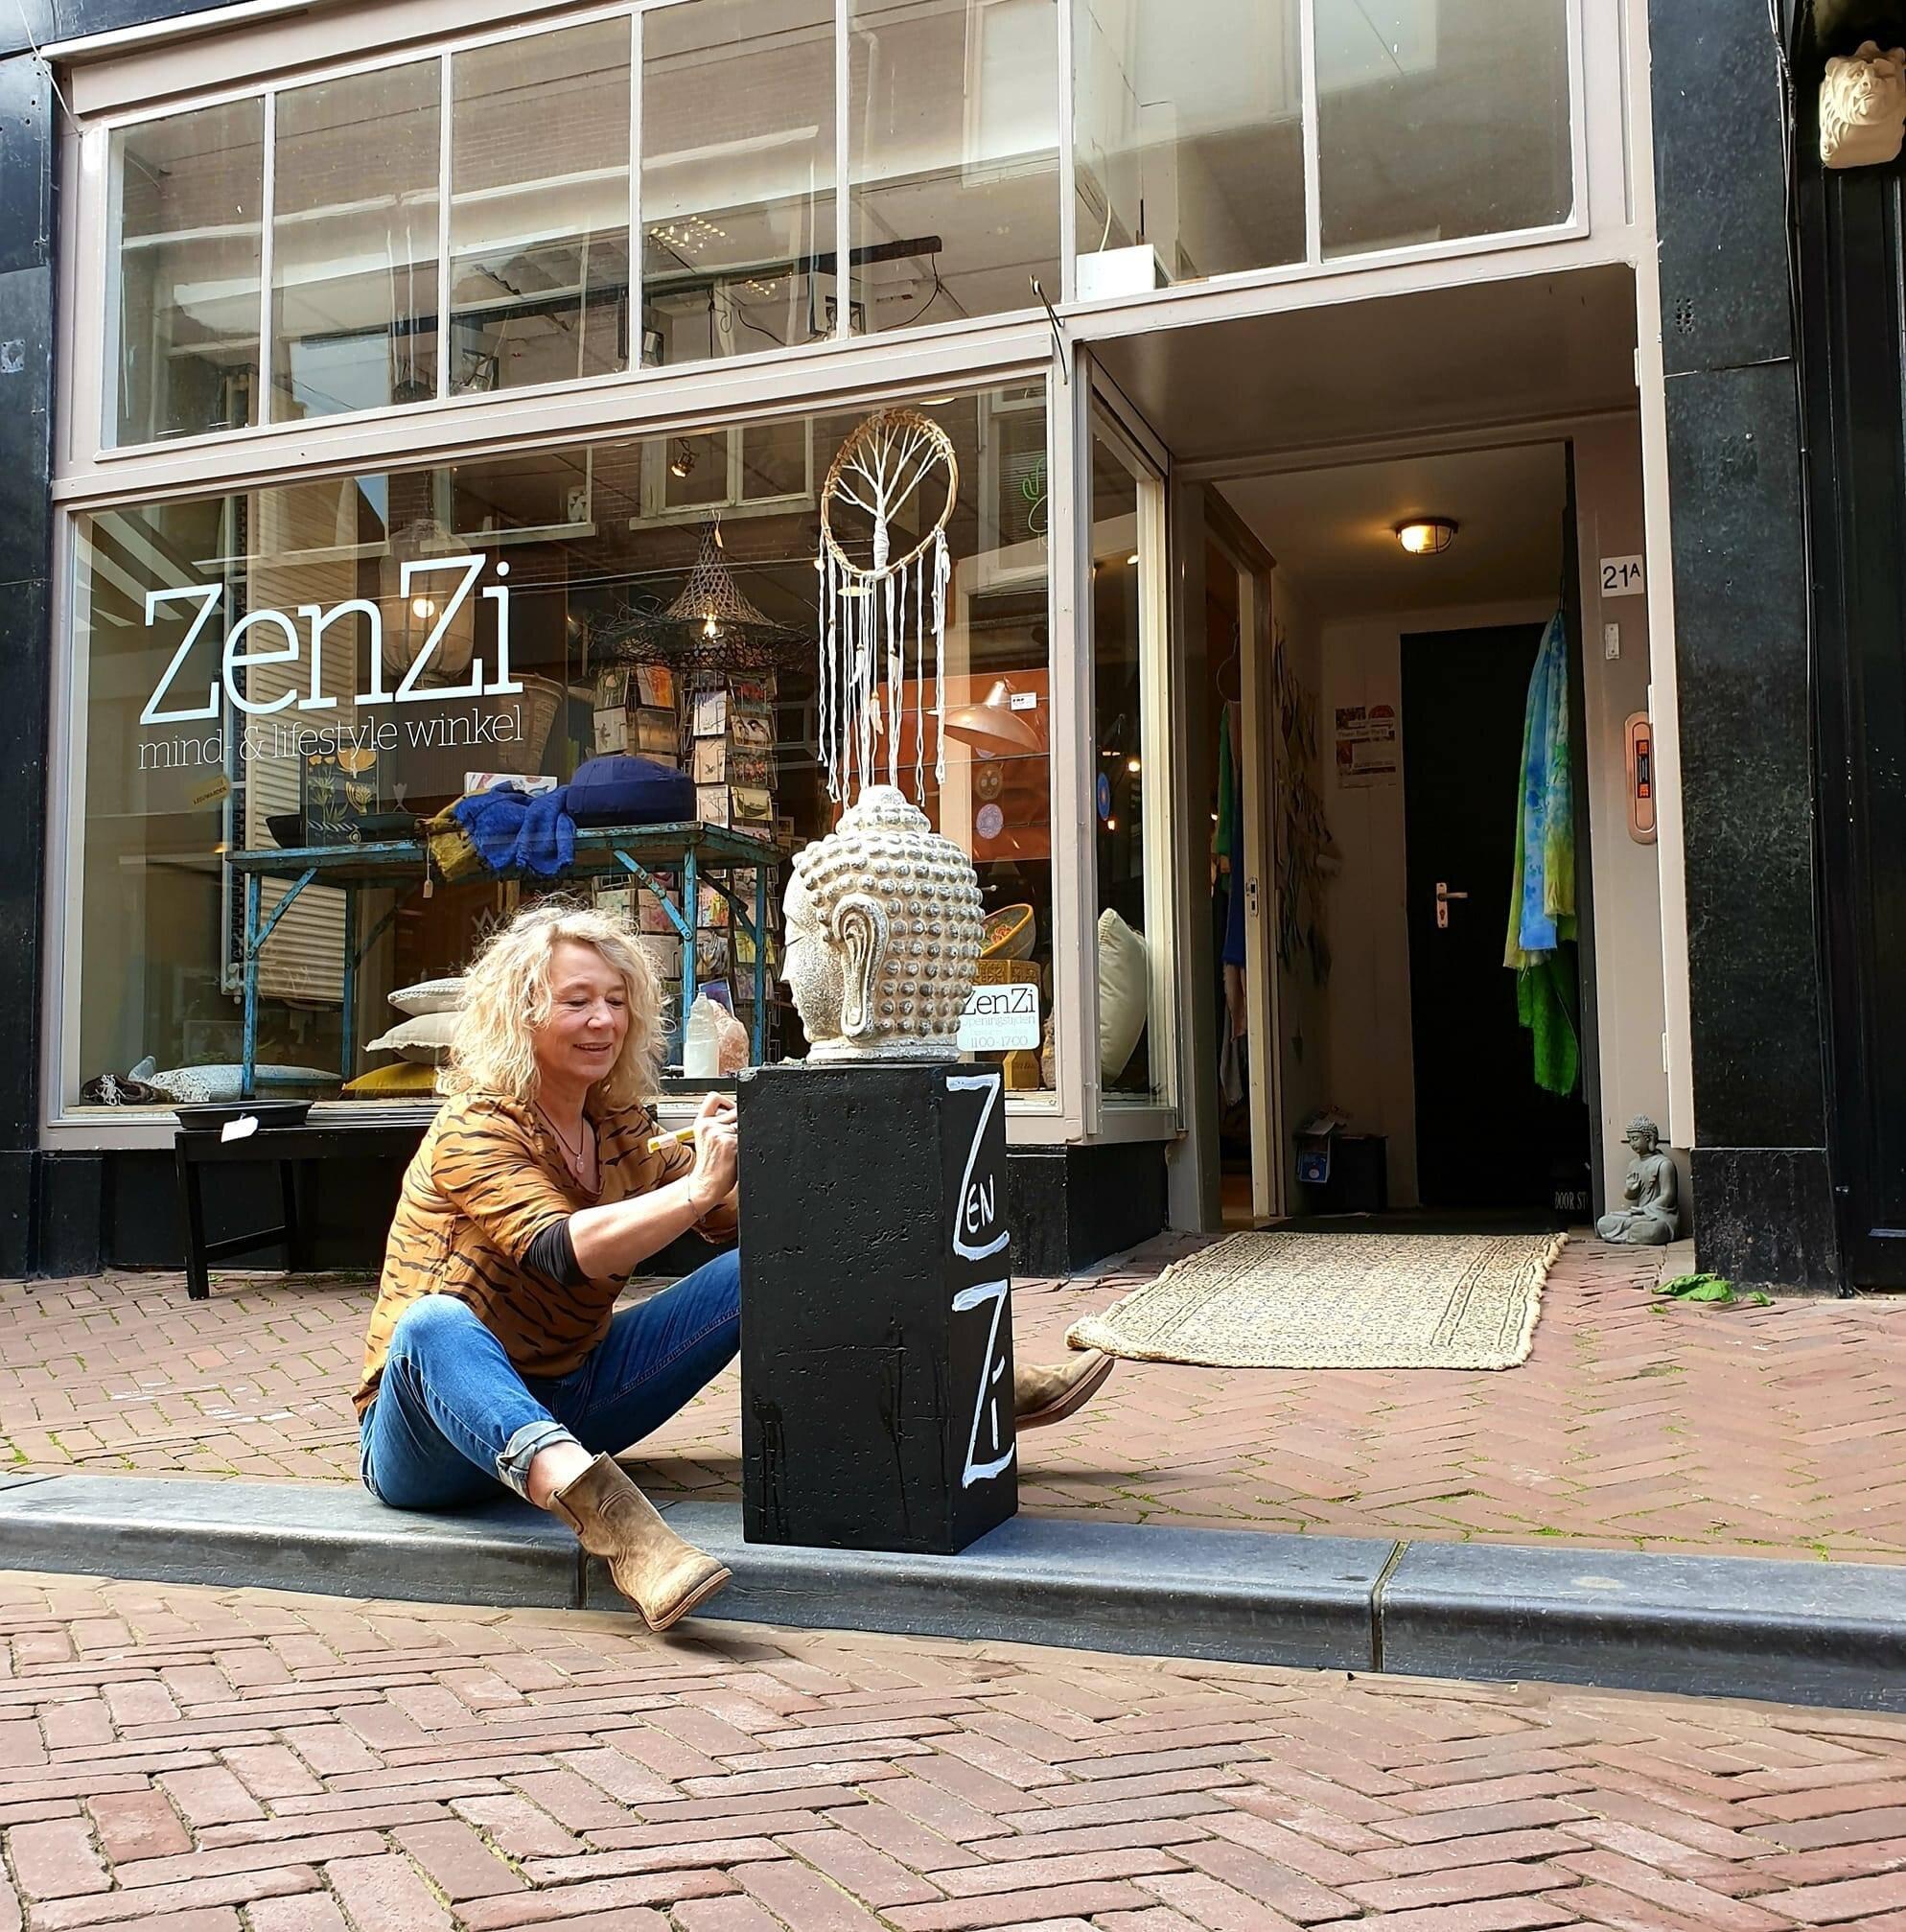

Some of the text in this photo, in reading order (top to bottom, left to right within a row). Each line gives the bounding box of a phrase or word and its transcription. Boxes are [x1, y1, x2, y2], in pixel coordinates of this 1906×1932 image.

[1603, 562, 1640, 590] 21A
[140, 553, 523, 725] ZenZi
[239, 725, 266, 761] &
[272, 715, 398, 760] lifestyle
[405, 704, 524, 749] winkel
[1576, 1191, 1589, 1210] ST
